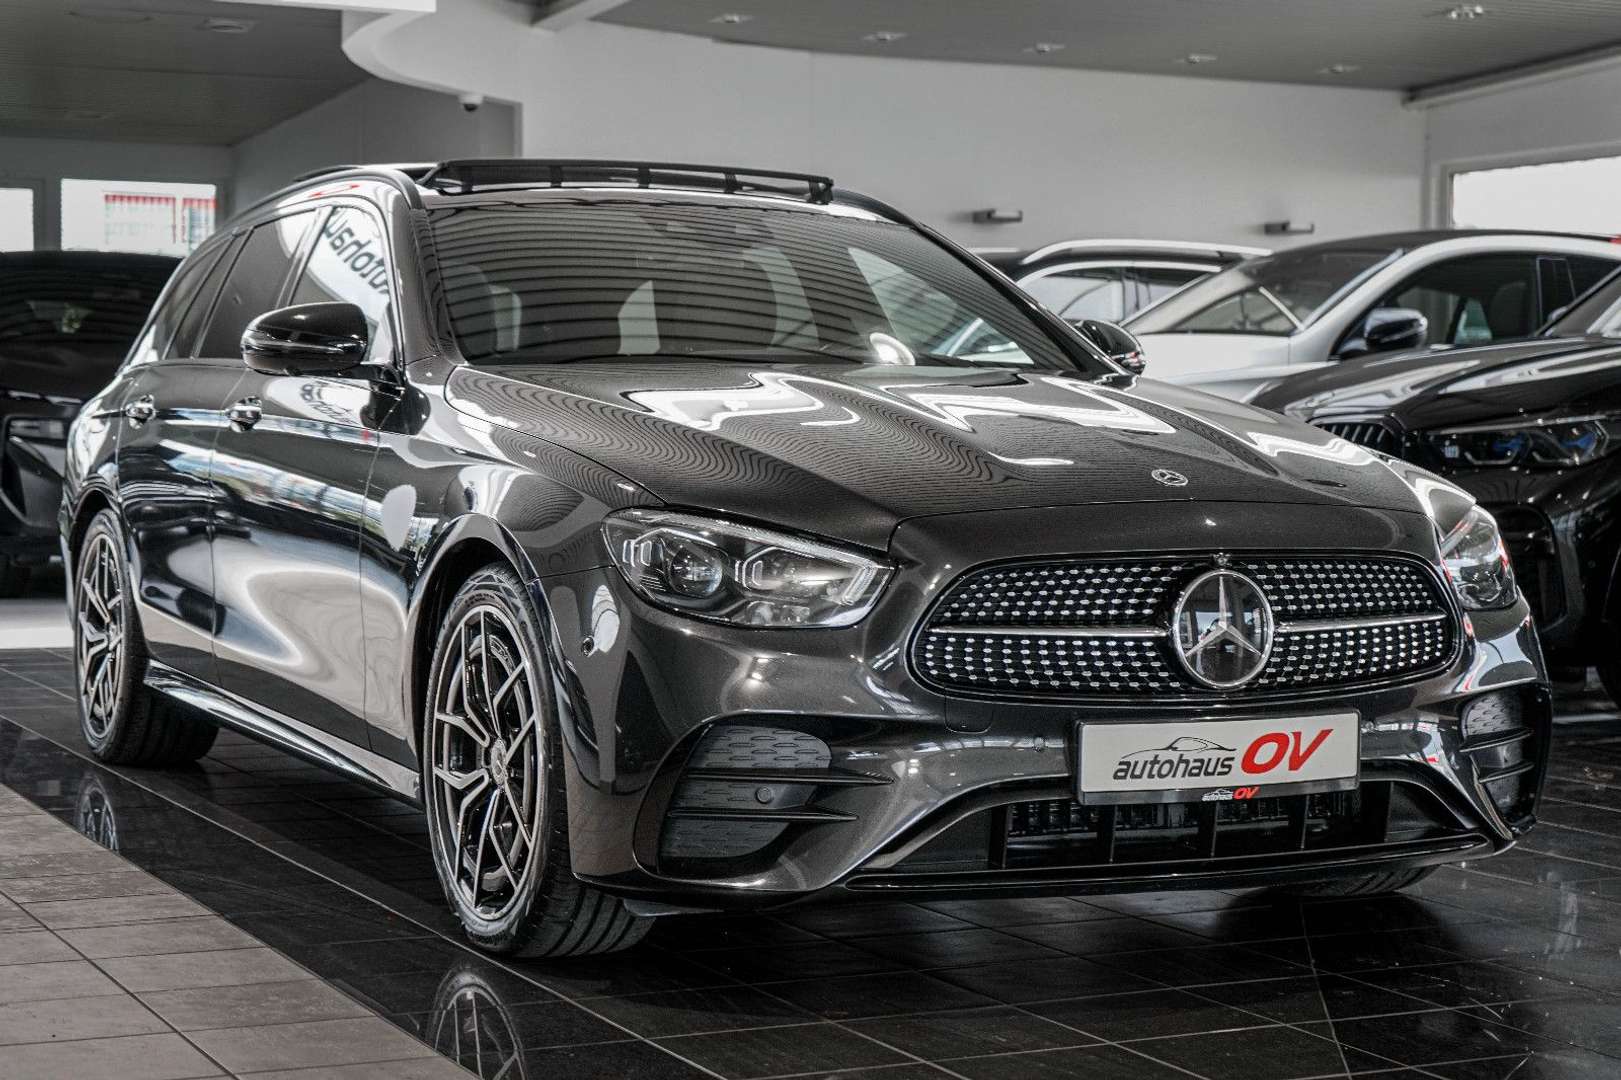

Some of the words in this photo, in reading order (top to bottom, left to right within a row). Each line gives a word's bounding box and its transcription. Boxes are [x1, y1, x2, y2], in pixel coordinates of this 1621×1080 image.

[1112, 753, 1235, 781] autohaus
[1240, 728, 1334, 775] OV
[1233, 786, 1260, 800] OV
